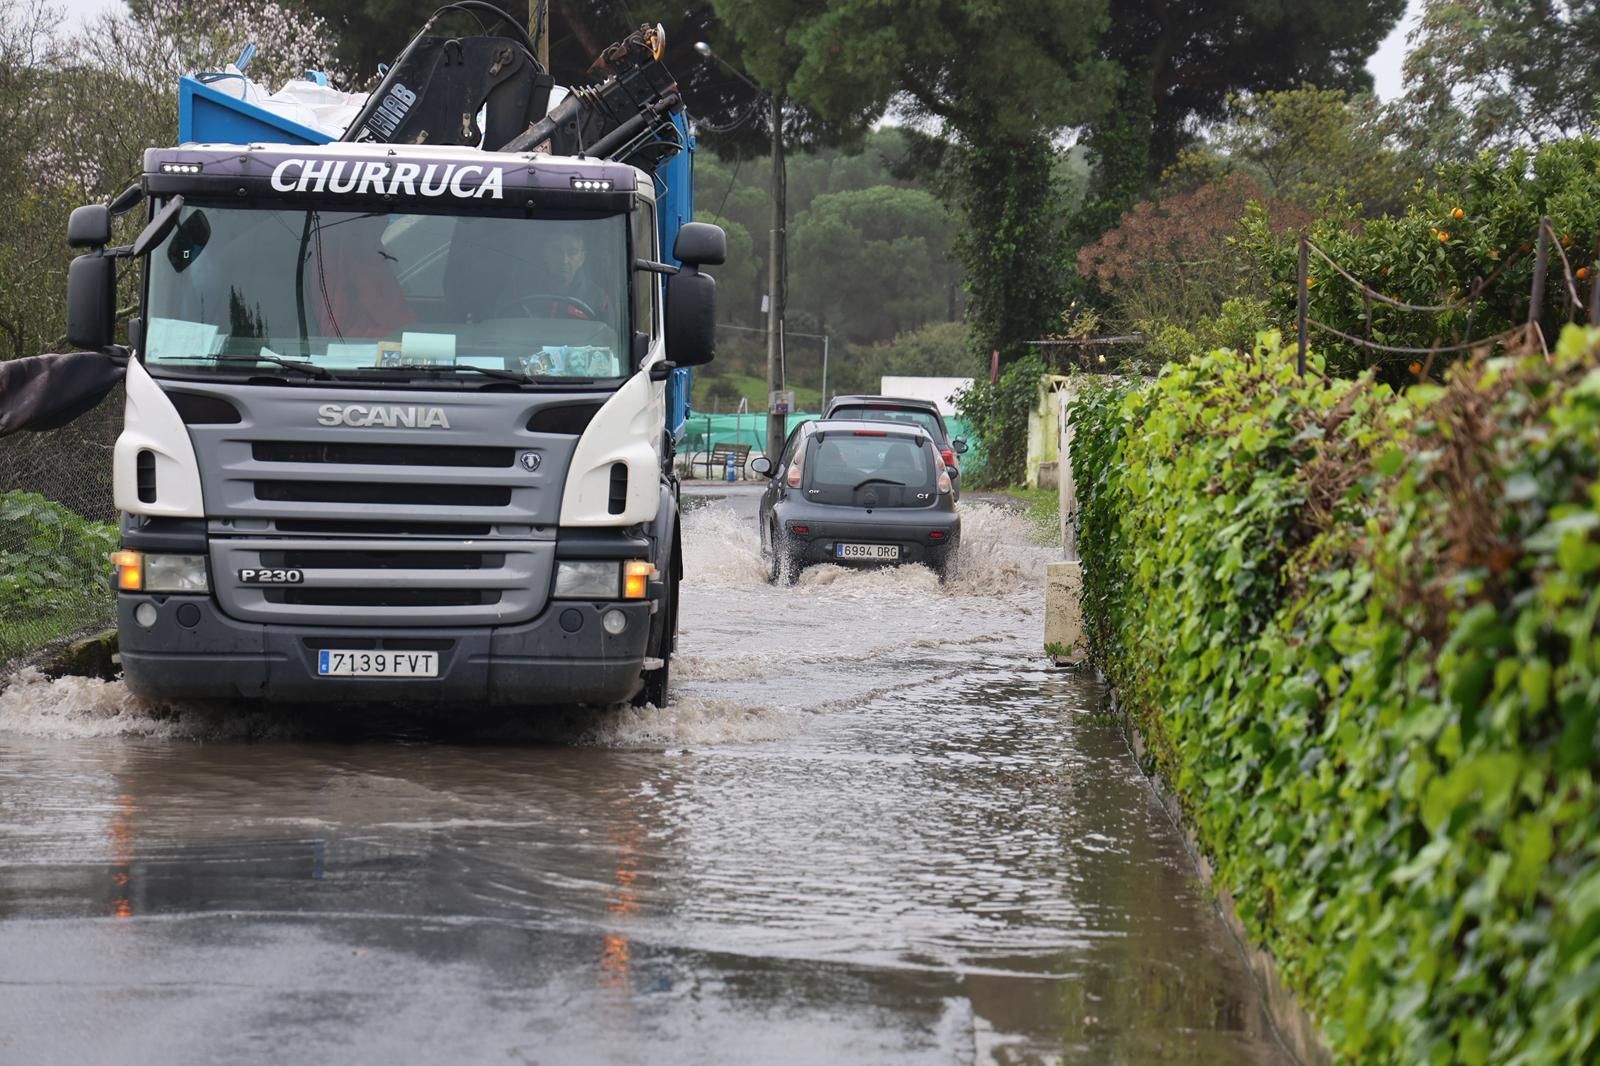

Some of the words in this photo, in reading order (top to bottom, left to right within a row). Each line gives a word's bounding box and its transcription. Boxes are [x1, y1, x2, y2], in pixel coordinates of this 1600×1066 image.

[368, 83, 416, 137] HIAB
[270, 159, 503, 199] CHURRUCA
[317, 404, 451, 428] SCANIA
[844, 545, 872, 556] 6994
[877, 546, 897, 557] DRG
[242, 569, 256, 581] P
[258, 569, 301, 582] 230
[333, 653, 386, 672] 7139
[394, 655, 433, 673] FVT
